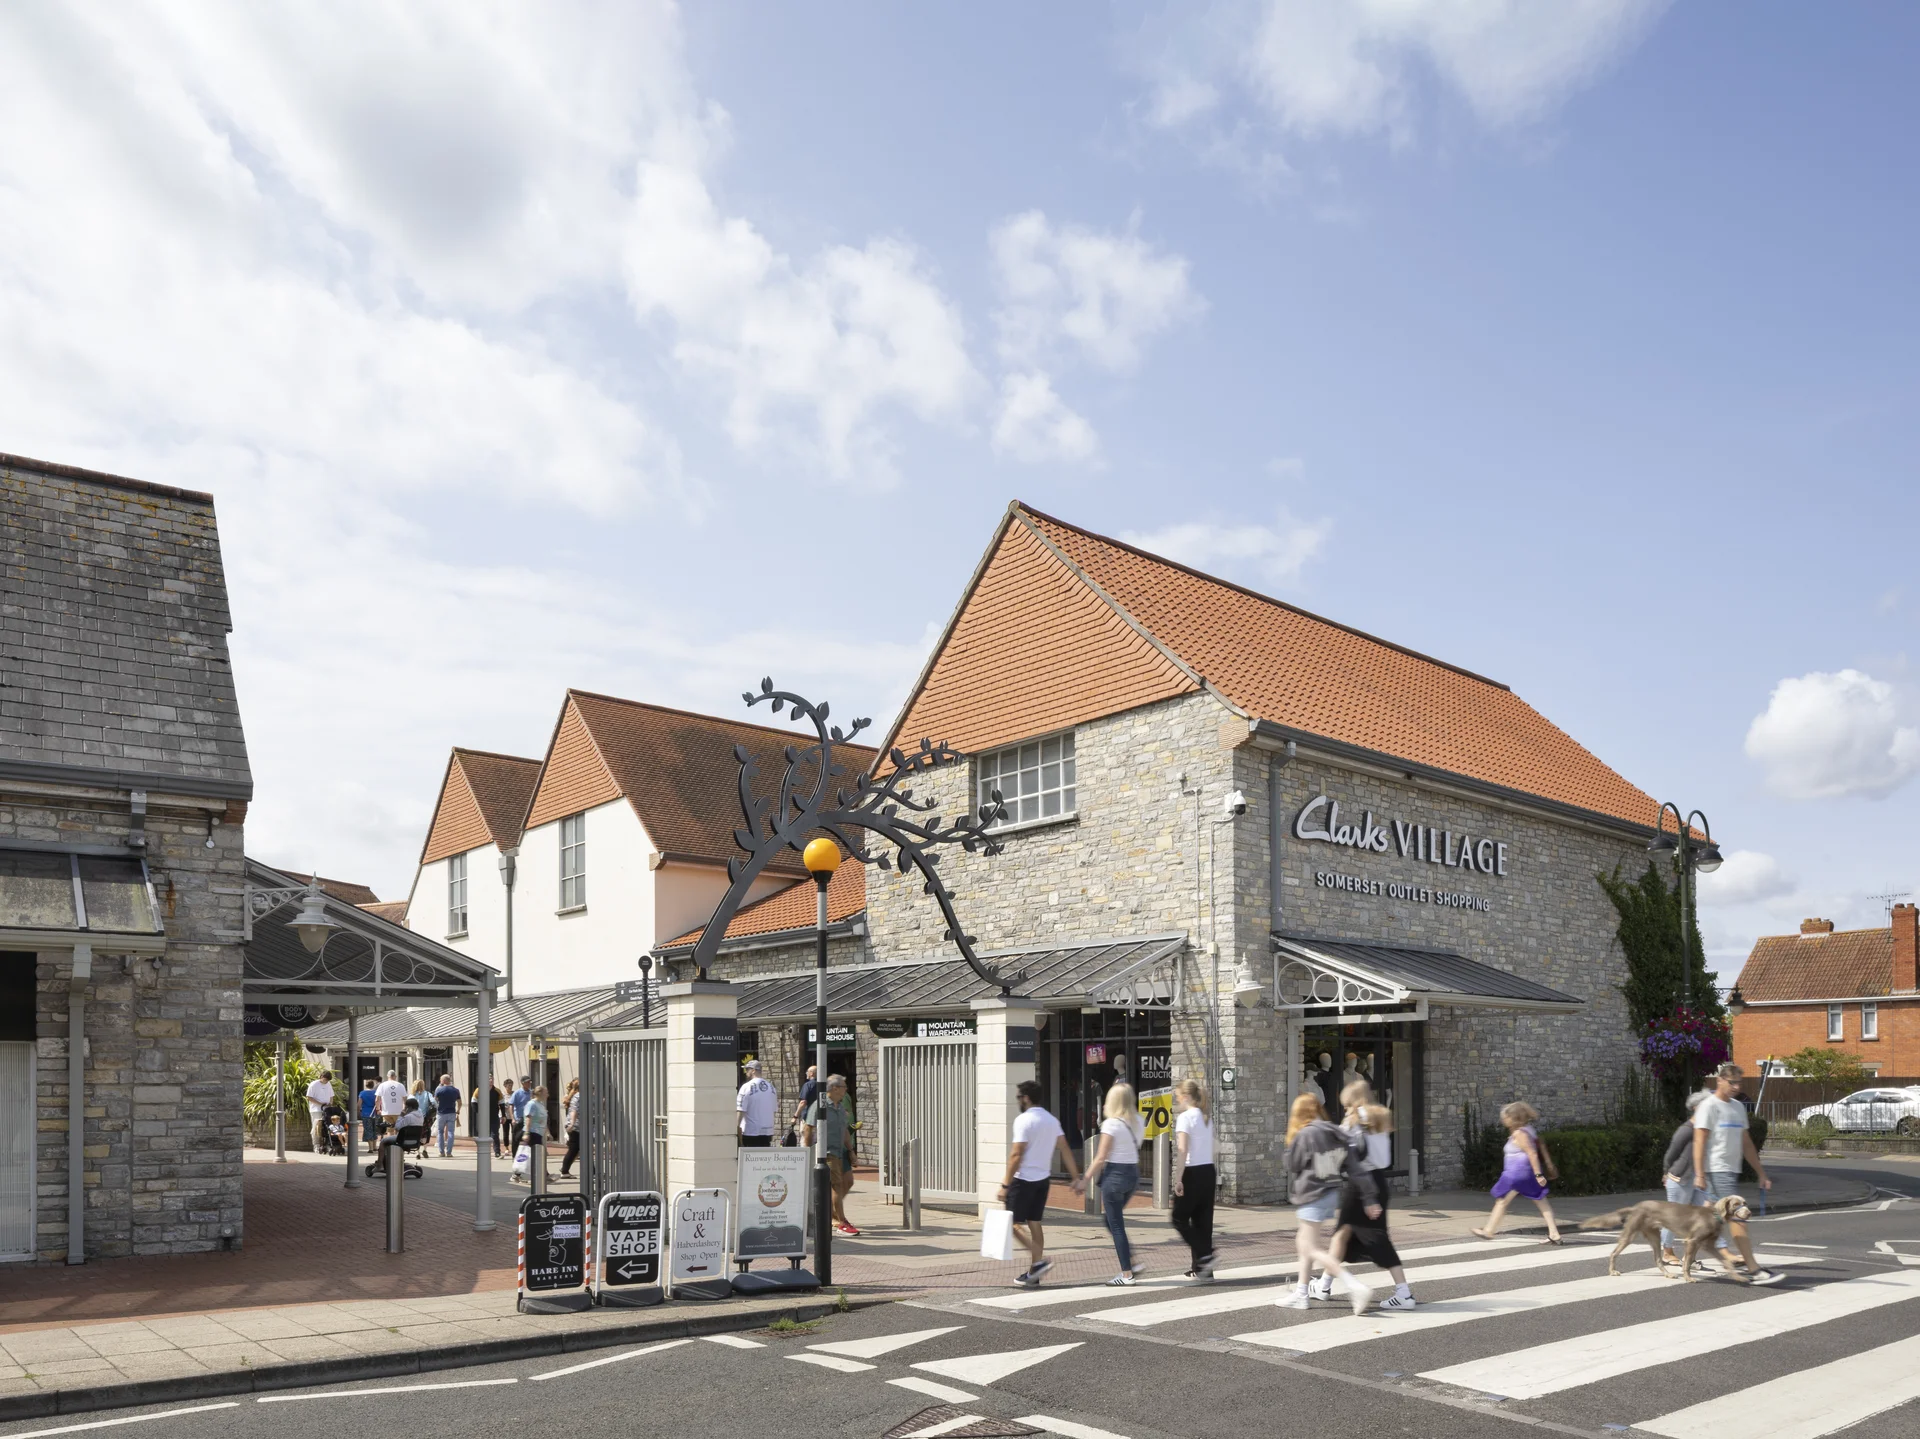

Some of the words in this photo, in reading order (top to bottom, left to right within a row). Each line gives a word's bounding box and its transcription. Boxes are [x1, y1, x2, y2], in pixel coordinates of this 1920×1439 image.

[1292, 795, 1388, 852] Clarks
[1392, 820, 1508, 876] VILLAGE
[1316, 872, 1385, 896] SOMERSET
[1388, 883, 1432, 902] OUTLET
[1435, 891, 1490, 912] SHOPPING
[928, 1021, 966, 1029] MOUNTAIN
[1140, 1056, 1171, 1070] FINA
[745, 1154, 772, 1162] Runway
[774, 1154, 804, 1163] Boutique
[551, 1206, 575, 1218] Open
[609, 1205, 659, 1220] Vapers
[682, 1207, 715, 1221] Craft
[694, 1223, 706, 1238] &
[610, 1231, 657, 1243] VAPE
[610, 1242, 656, 1255] SHOP
[677, 1240, 721, 1248] Haberdashery
[681, 1253, 696, 1261] Shop
[700, 1252, 718, 1260] Open
[532, 1267, 558, 1275] HARE
